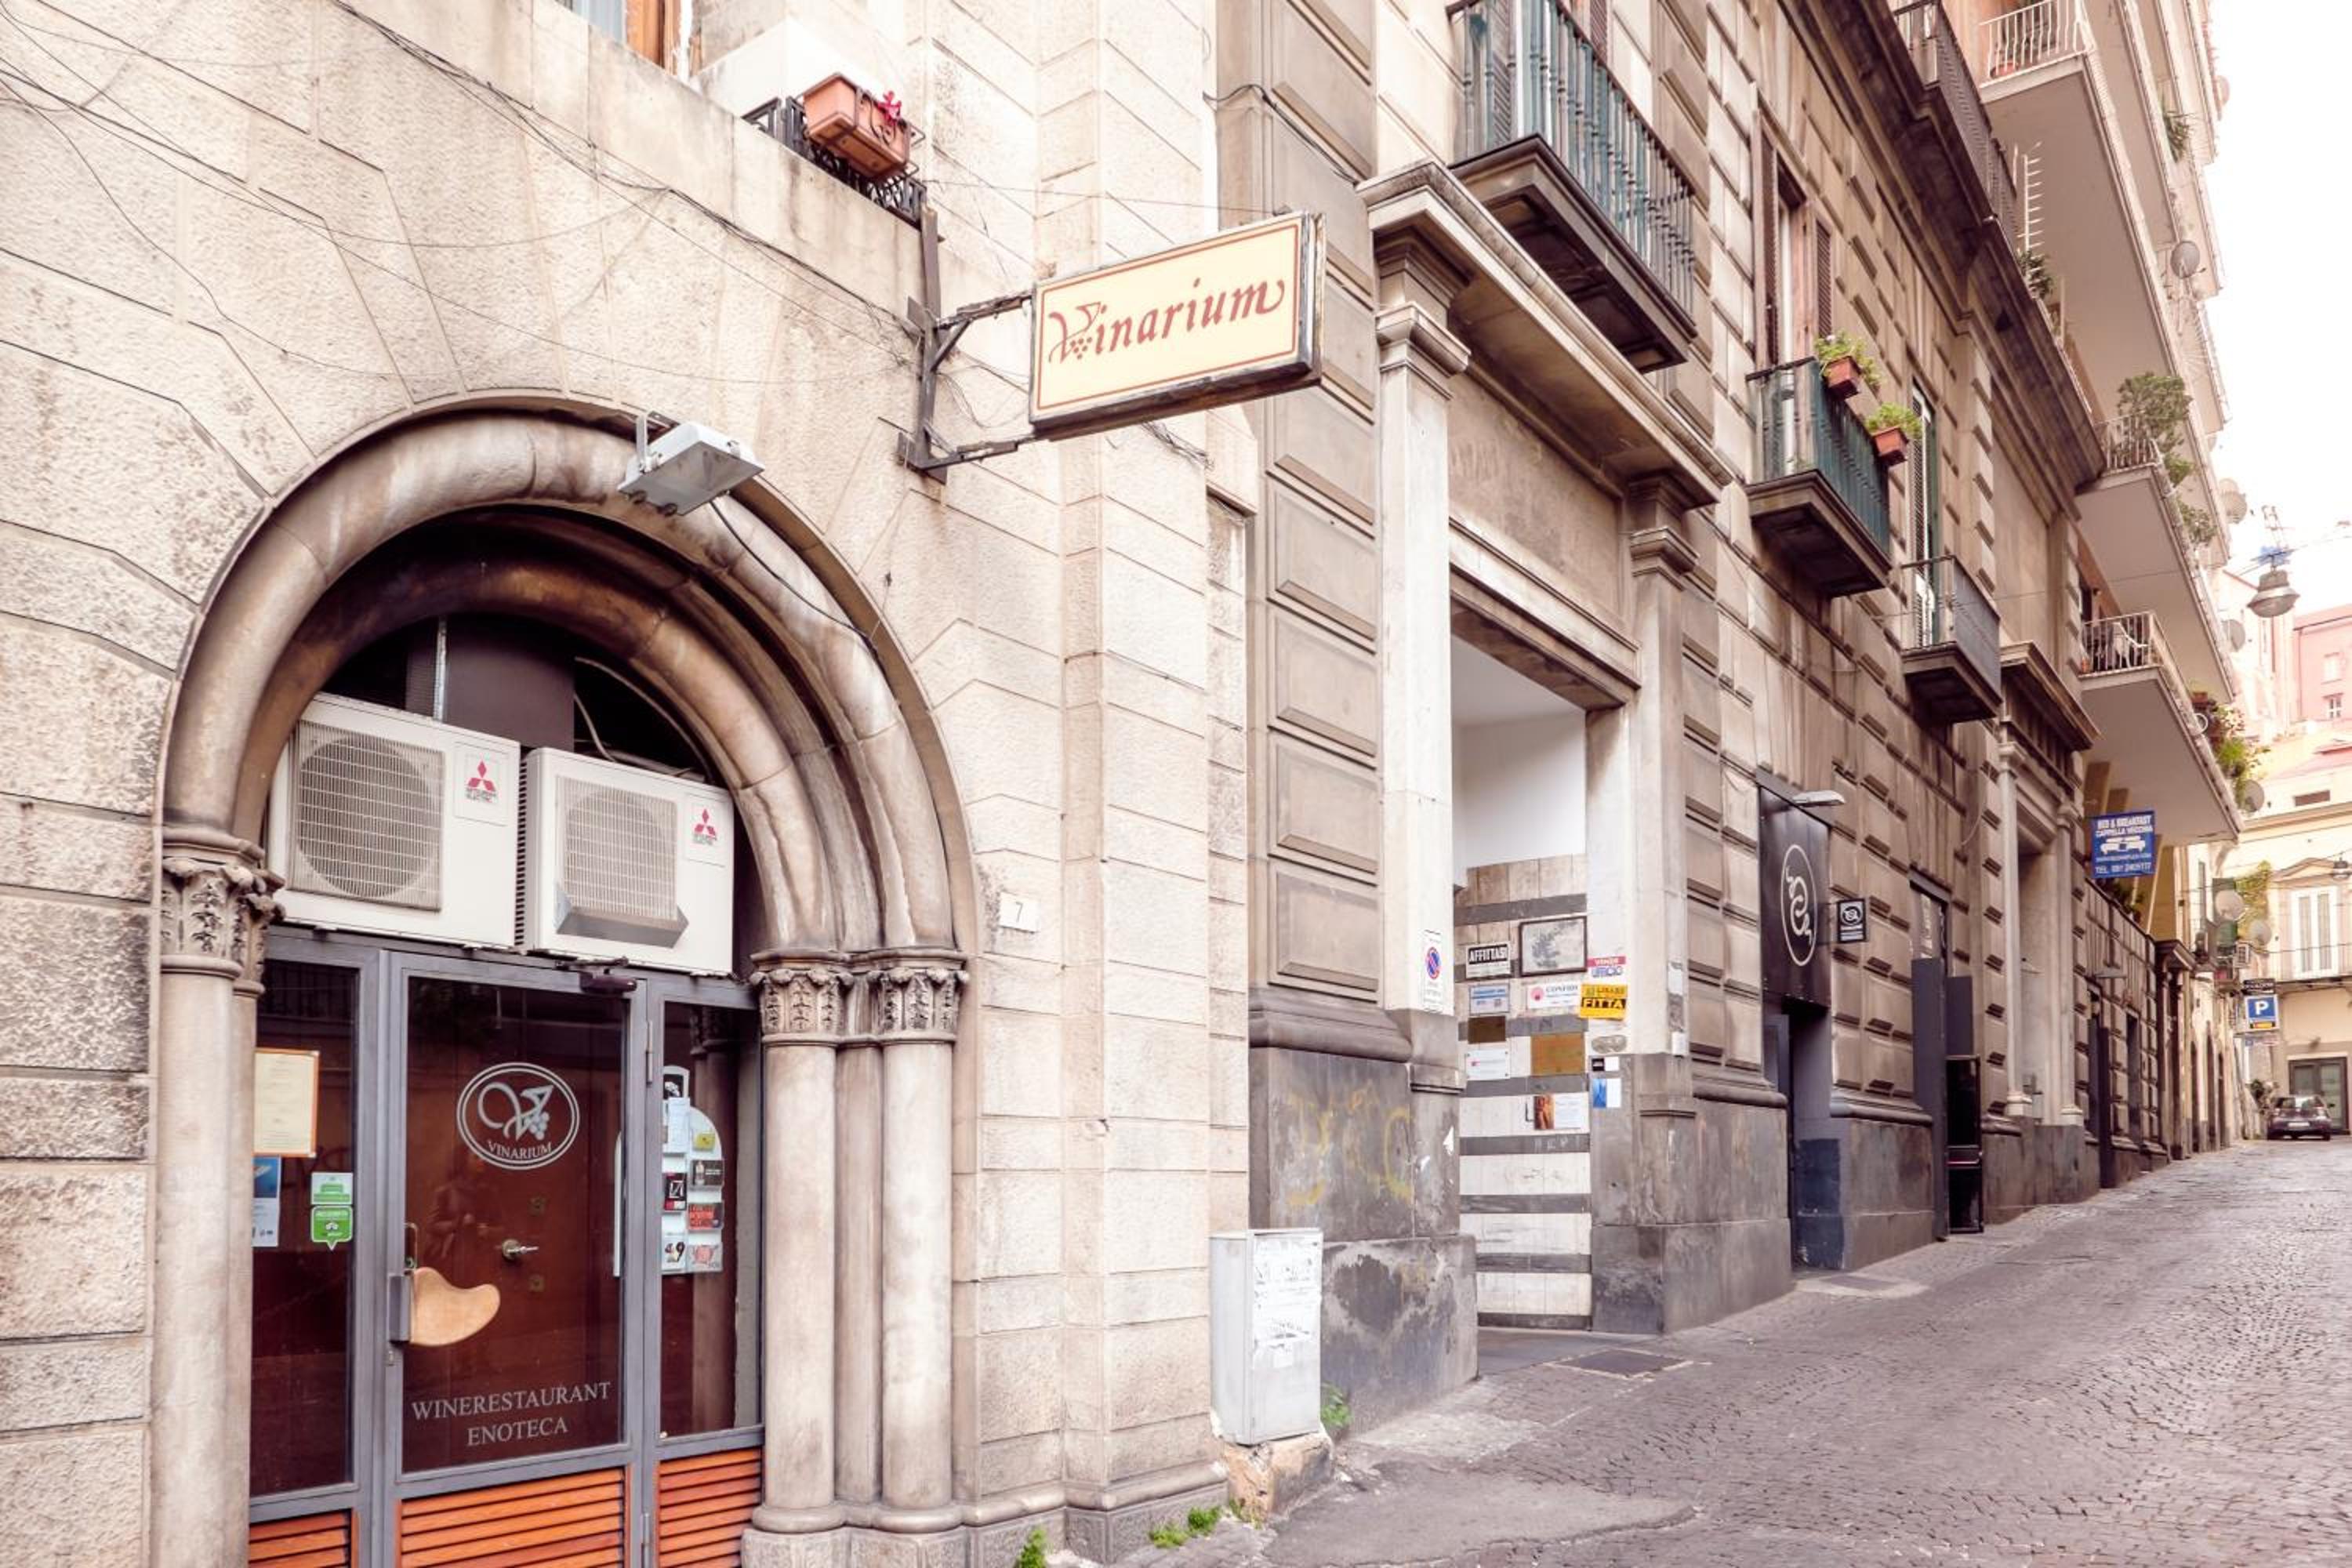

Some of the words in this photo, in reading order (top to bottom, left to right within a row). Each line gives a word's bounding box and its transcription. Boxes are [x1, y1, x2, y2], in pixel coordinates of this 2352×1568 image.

[1047, 276, 1286, 364] Vinarium
[1014, 901, 1023, 924] 7
[1584, 997, 1624, 1010] FITTA
[2255, 1000, 2269, 1015] P
[487, 1140, 552, 1160] VINARIUM
[411, 1381, 612, 1421] WINERESTAURANT
[466, 1417, 569, 1446] ENOTECA
